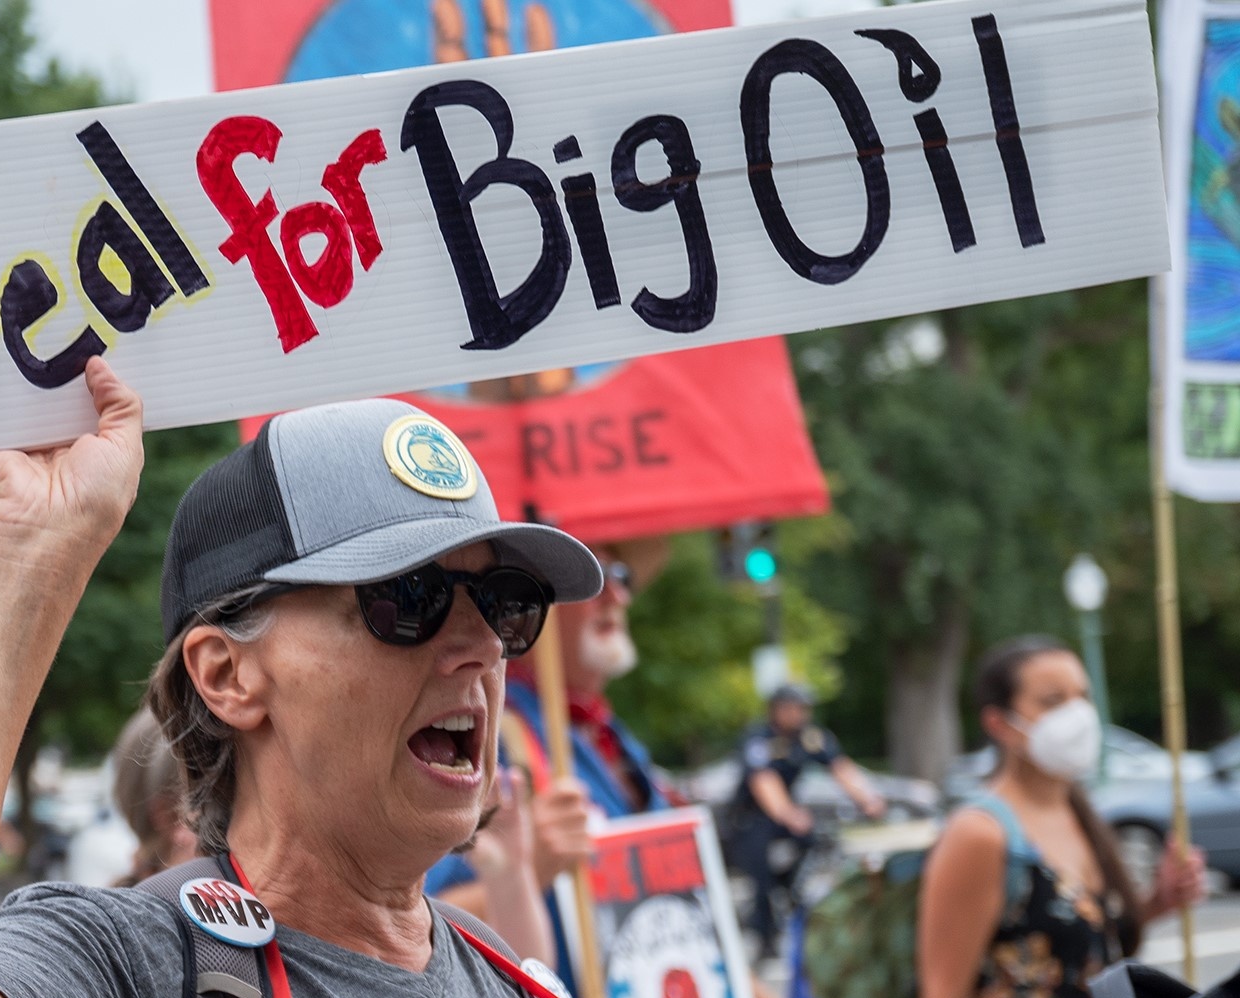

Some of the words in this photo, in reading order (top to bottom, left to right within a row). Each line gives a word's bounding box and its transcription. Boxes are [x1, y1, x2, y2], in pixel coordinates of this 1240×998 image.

[196, 115, 388, 353] for
[400, 79, 718, 351] Big
[740, 13, 1046, 285] Oil
[522, 408, 669, 478] RISE
[186, 893, 270, 930] MVP
[192, 880, 241, 908] NO
